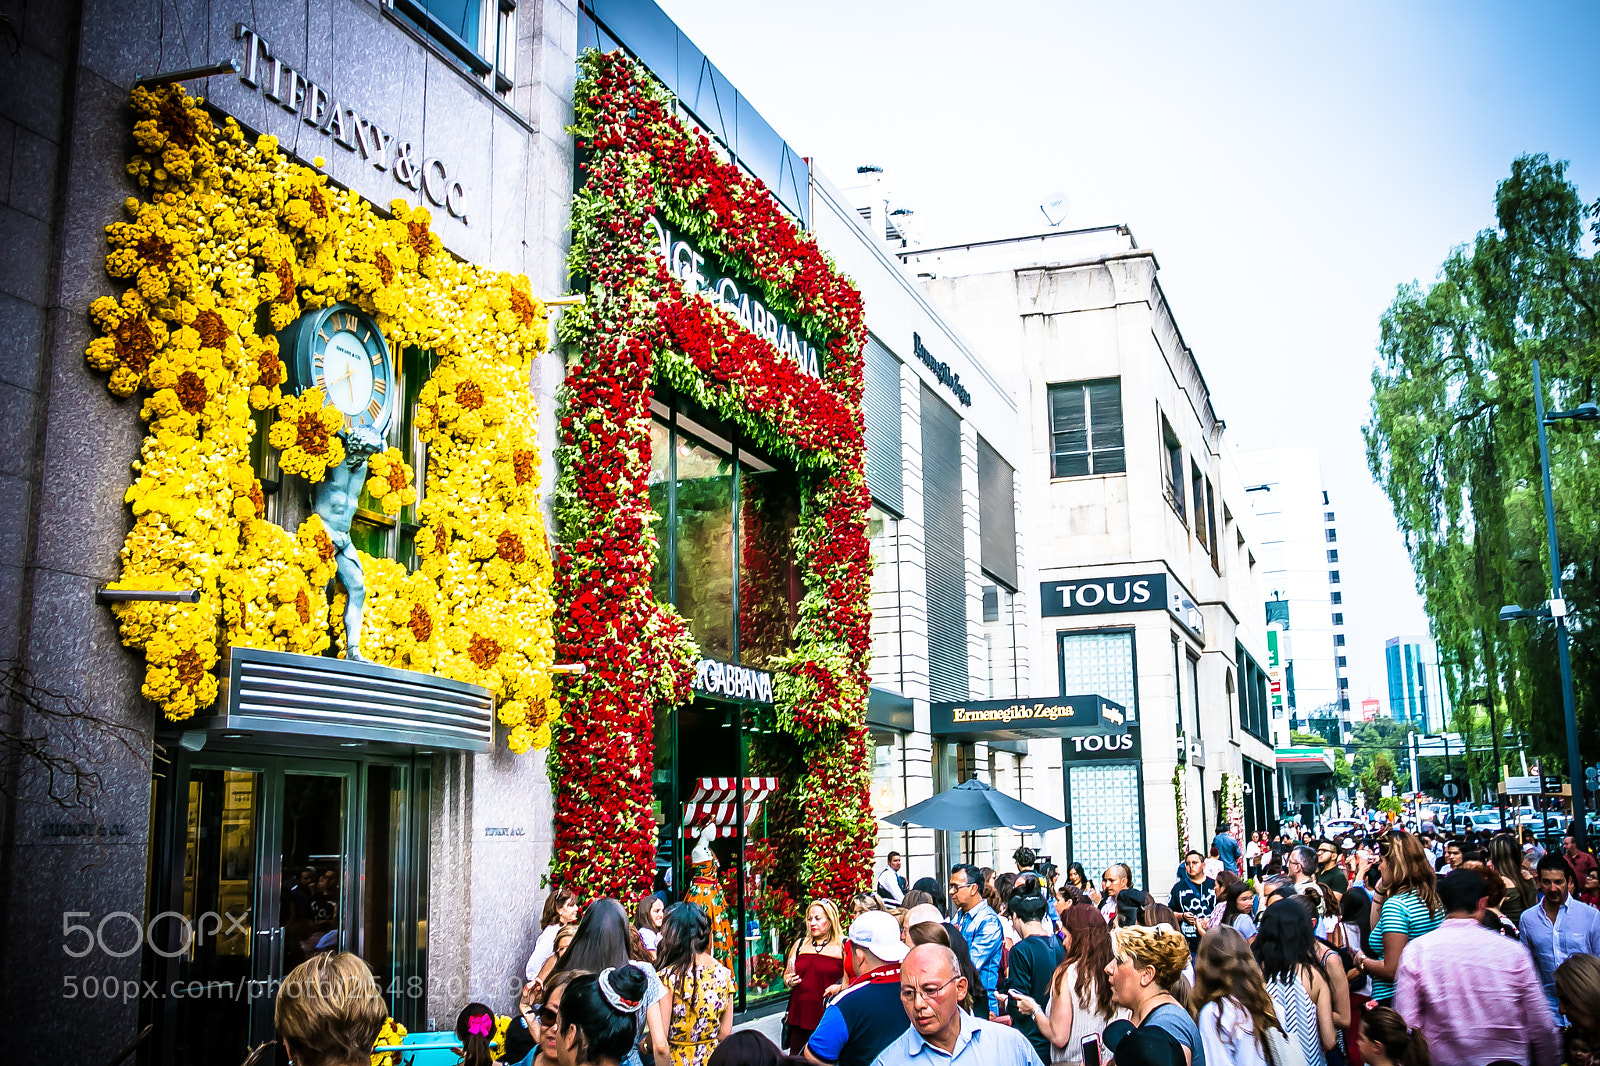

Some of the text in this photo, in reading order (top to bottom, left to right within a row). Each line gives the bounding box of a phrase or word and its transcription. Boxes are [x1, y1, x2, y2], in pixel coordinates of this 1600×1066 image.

[1056, 580, 1151, 608] TOUS
[704, 658, 774, 704] GABBANA
[953, 704, 1074, 723] Ermenegildo Zegna
[1071, 734, 1133, 753] TOUS
